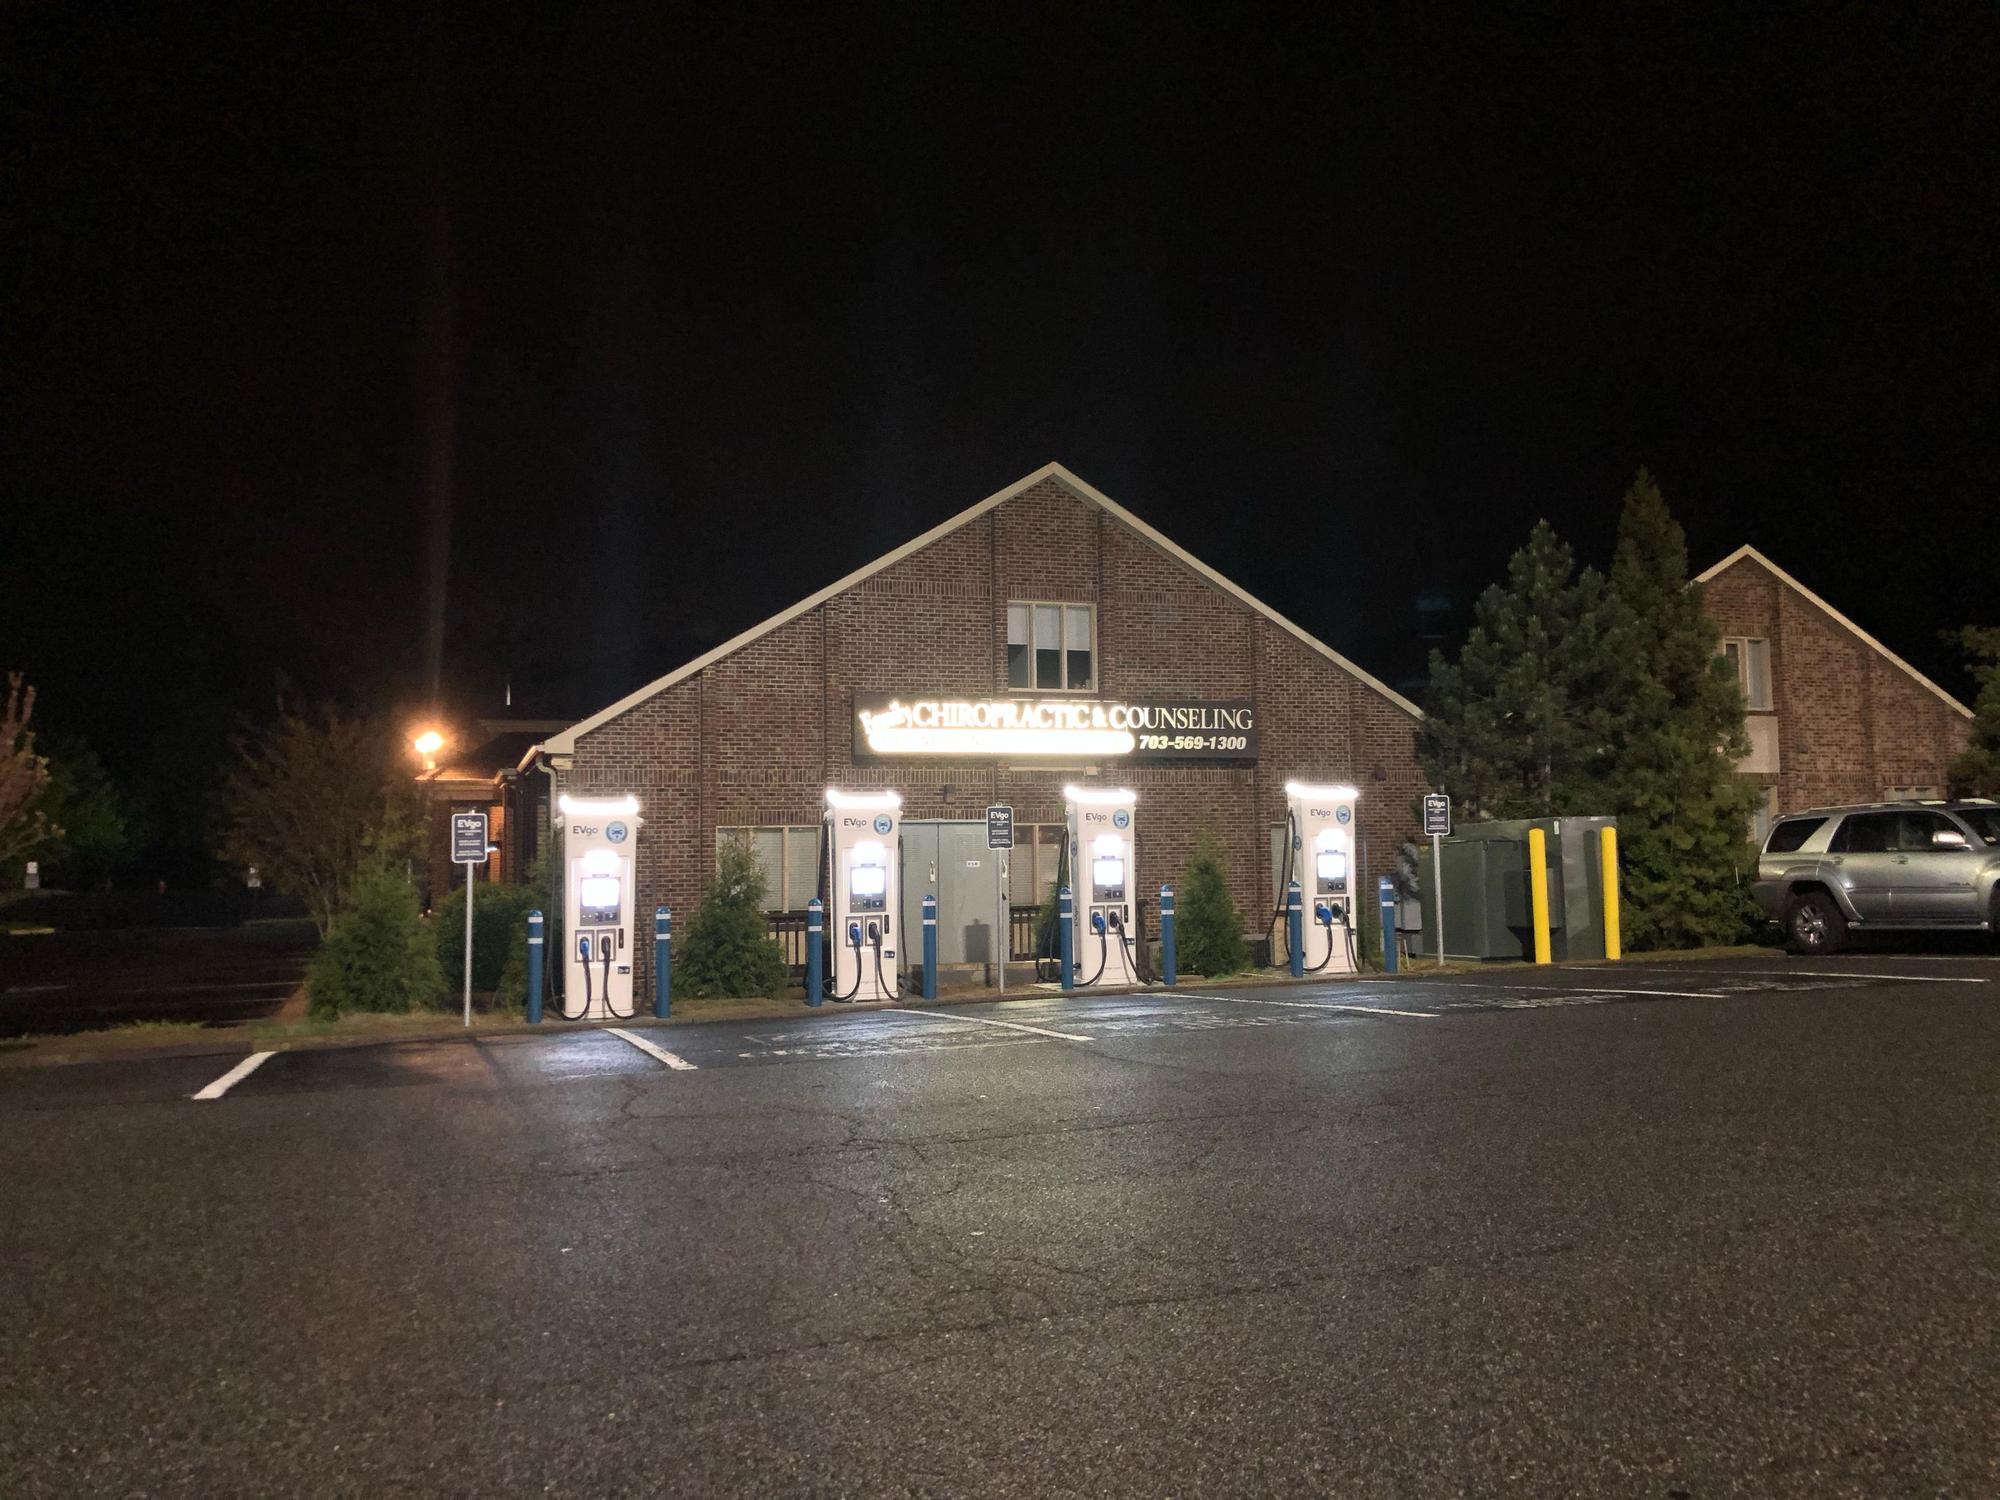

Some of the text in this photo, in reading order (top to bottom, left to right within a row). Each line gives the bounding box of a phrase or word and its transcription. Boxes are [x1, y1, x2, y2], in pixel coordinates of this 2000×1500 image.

[859, 700, 1253, 734] Fly CHIROPRACTIC & COUNSELING
[1139, 735, 1247, 750] 703-569-1300
[1428, 800, 1445, 808] EVgo
[990, 811, 1009, 820] EVgo
[1085, 812, 1107, 823] EVgo
[1310, 808, 1332, 818] EVgo
[457, 819, 482, 829] EVgo
[844, 818, 867, 828] EVgo
[573, 825, 598, 837] EVgo
